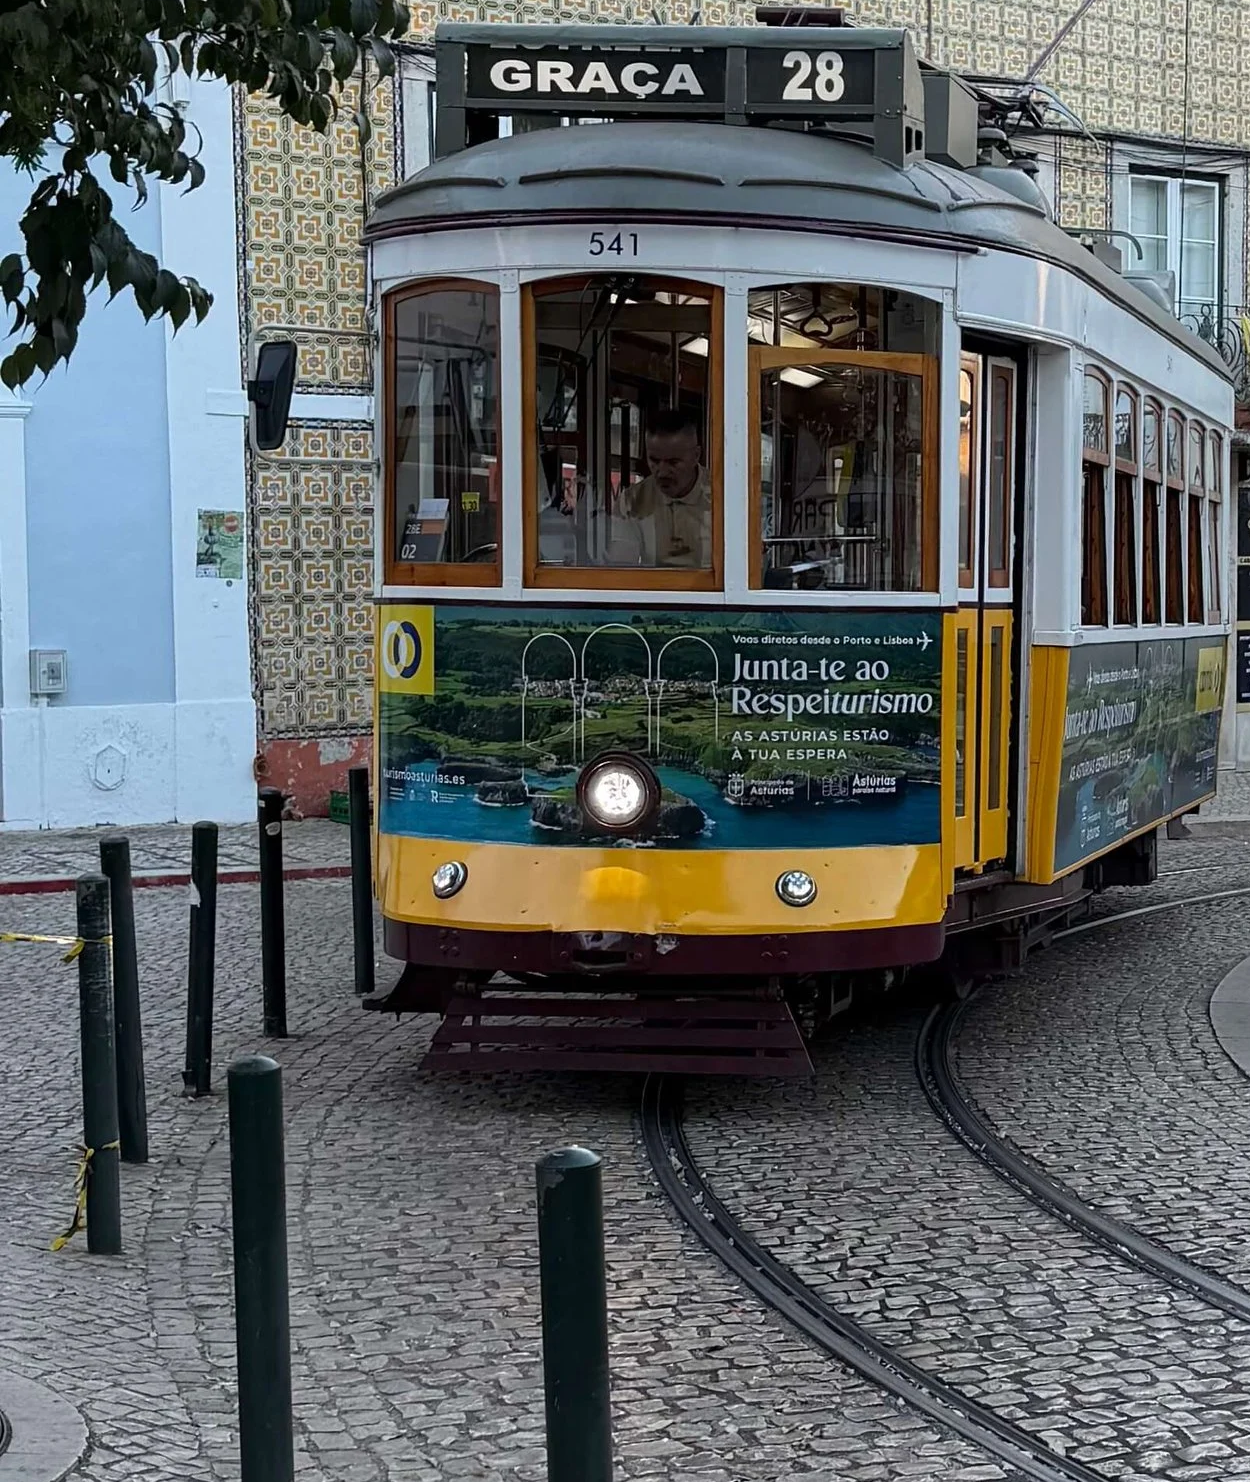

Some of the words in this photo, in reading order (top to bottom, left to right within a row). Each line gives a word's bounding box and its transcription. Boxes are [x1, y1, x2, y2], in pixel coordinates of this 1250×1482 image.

[490, 59, 705, 99] GRAÇA
[782, 51, 845, 101] 28
[589, 232, 640, 257] 541
[401, 544, 417, 559] 02
[732, 634, 759, 644] Voos
[761, 634, 798, 645] diretos
[800, 634, 831, 645] desde
[843, 635, 871, 645] Porto
[883, 635, 914, 645] Lisboa
[732, 653, 846, 683] Junta-te
[855, 660, 890, 681] ao
[731, 686, 933, 722] Respeiturismo
[731, 730, 754, 742] AS
[759, 728, 838, 742] ASTÚRIAS
[843, 727, 890, 741] ESTÃO
[731, 746, 743, 760] À
[750, 749, 780, 760] TUA
[787, 749, 848, 760] ESPERA
[852, 773, 896, 787] Astúrias
